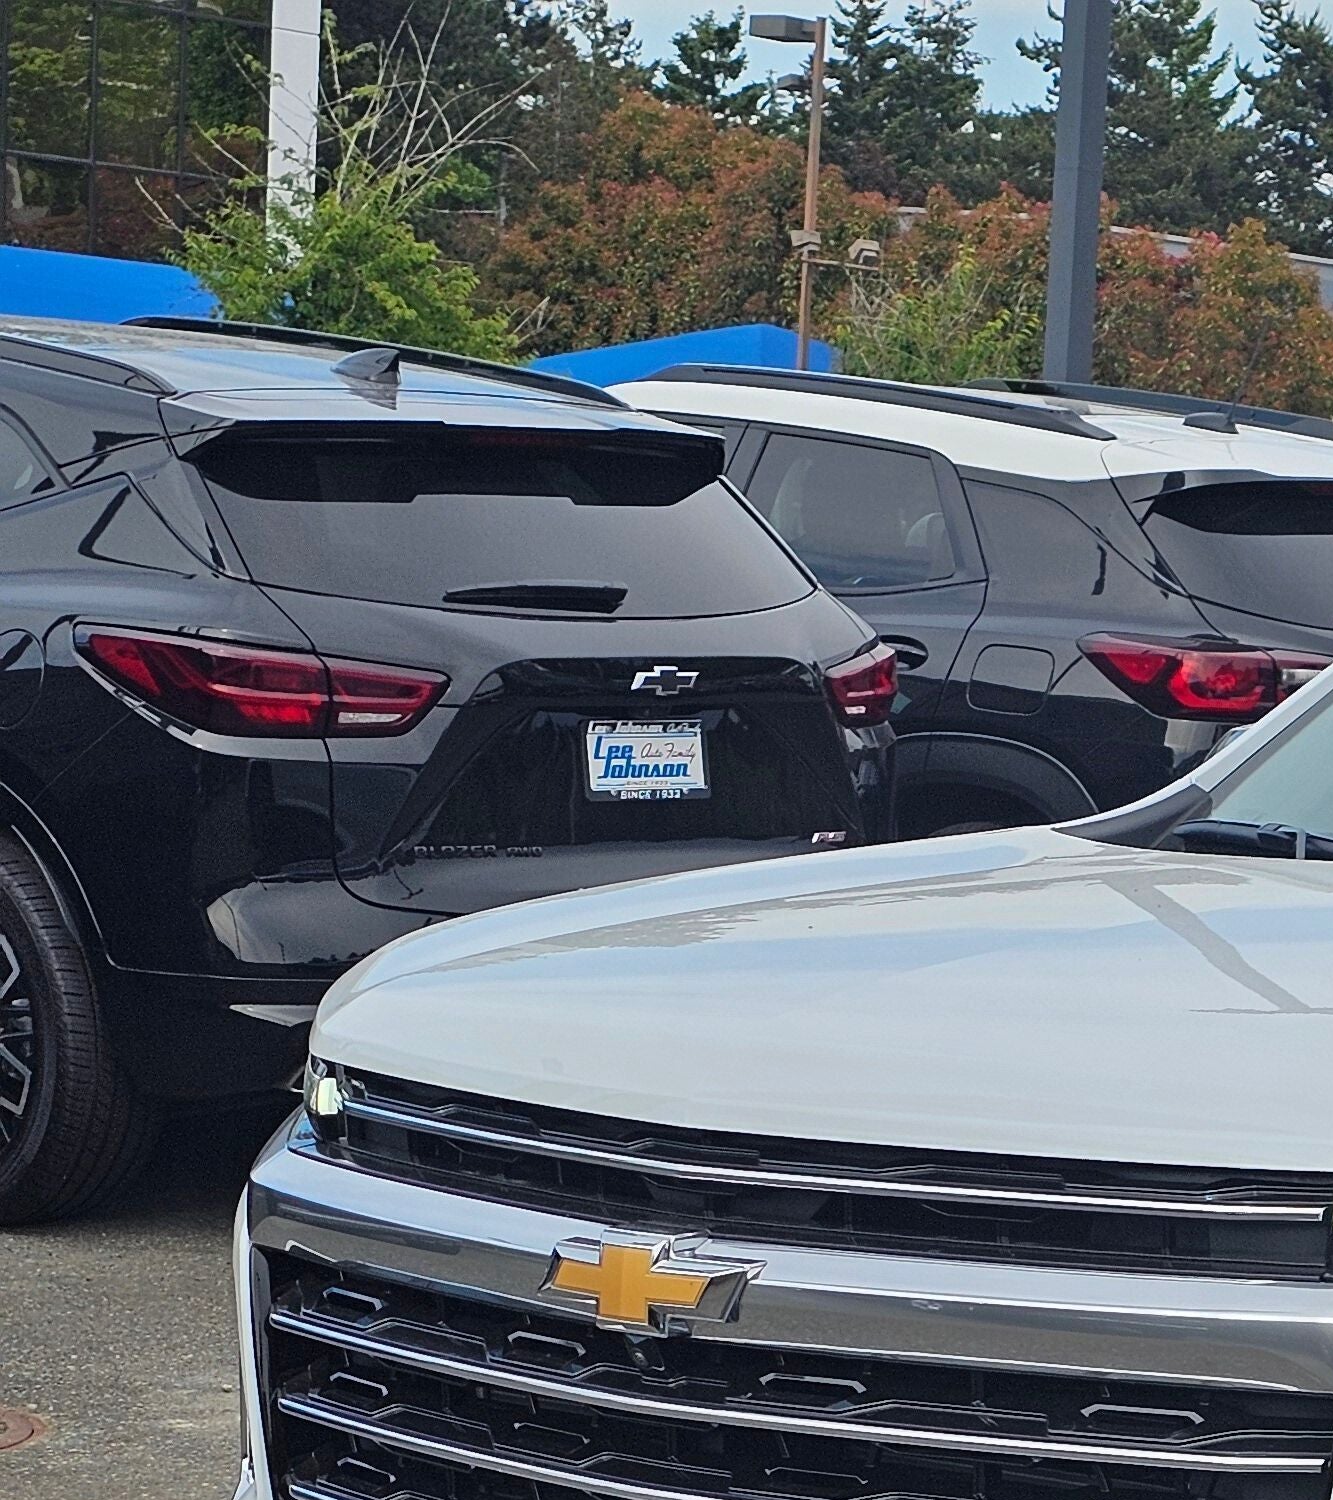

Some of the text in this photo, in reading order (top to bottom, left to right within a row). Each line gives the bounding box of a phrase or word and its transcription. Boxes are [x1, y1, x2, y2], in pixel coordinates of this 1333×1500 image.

[594, 736, 636, 759] Lee
[597, 756, 691, 779] Johnson
[620, 789, 681, 799] SINCE 1933
